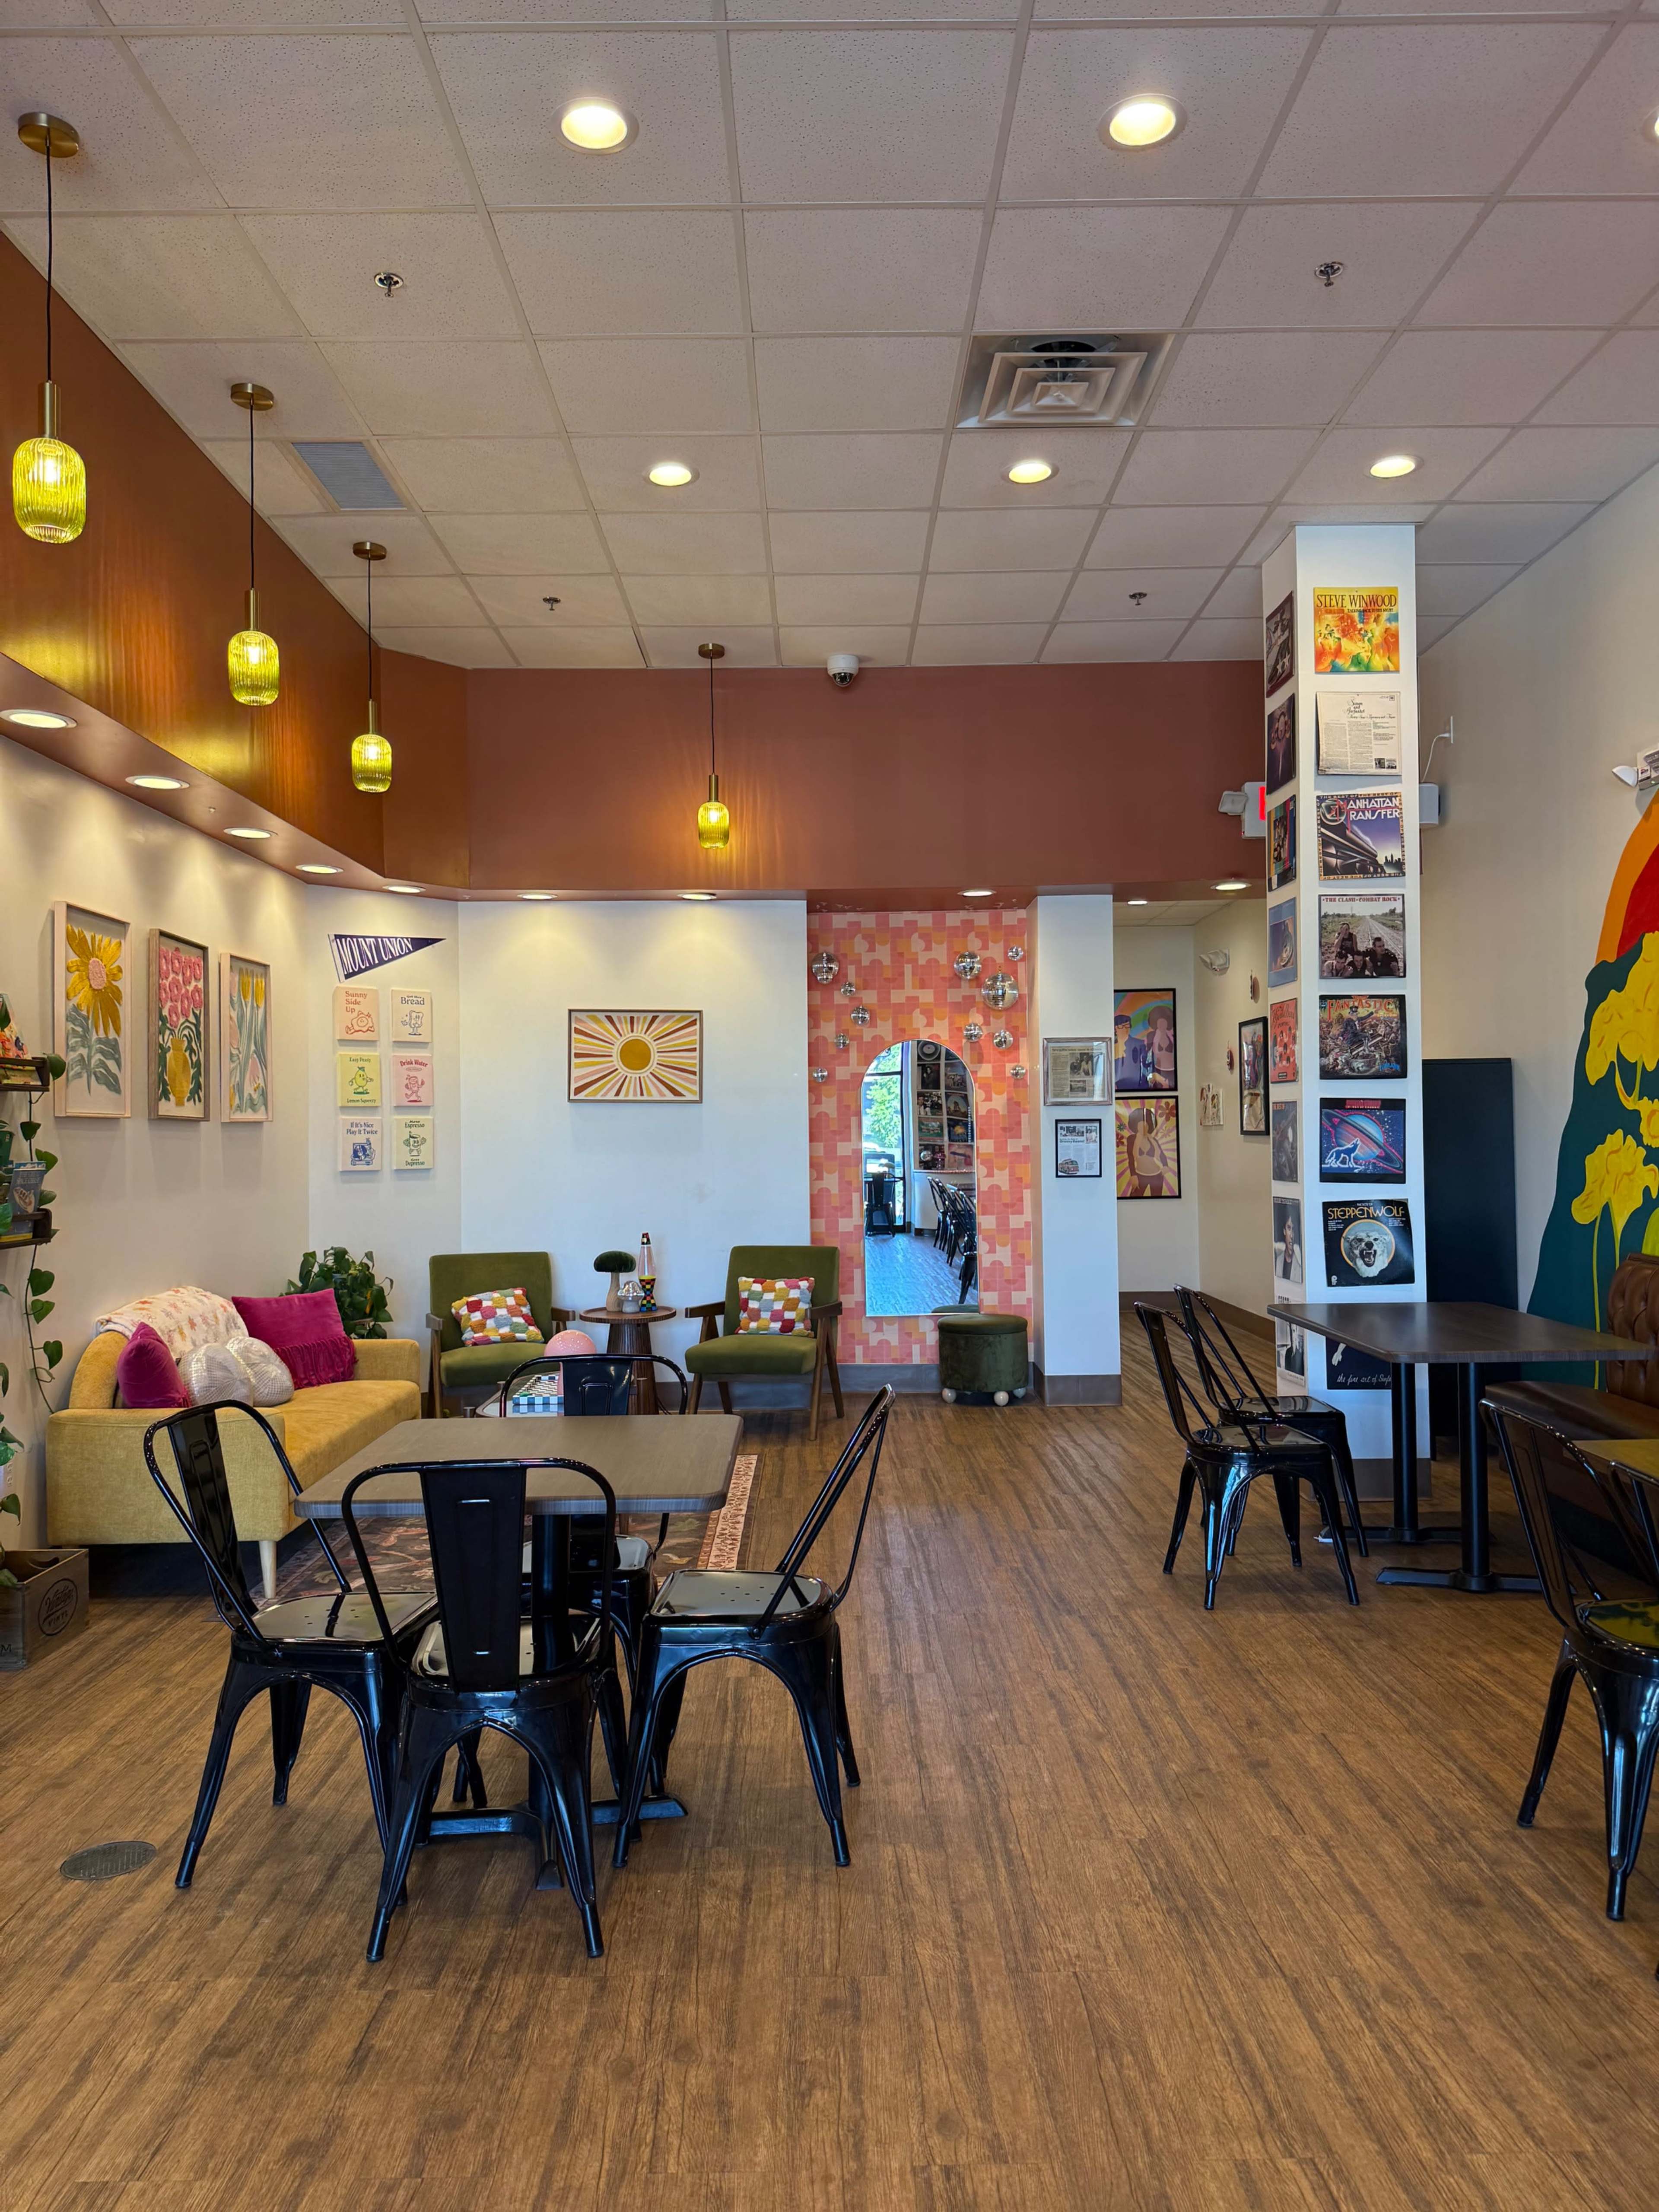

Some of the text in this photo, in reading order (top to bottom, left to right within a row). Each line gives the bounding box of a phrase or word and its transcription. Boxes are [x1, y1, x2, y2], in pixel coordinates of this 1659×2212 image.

[1316, 594, 1397, 608] STEVE WINWOOD
[337, 937, 413, 975] MOUNT UNION
[345, 991, 367, 999] Sunny
[401, 997, 425, 1005] Bread
[1327, 999, 1393, 1022] FANTASTIC
[414, 1059, 428, 1067] Water
[1328, 1205, 1405, 1219] STEPPENWOLF
[1337, 1373, 1346, 1382] the
[1347, 1374, 1358, 1386] fine
[1372, 1374, 1378, 1385] of
[1379, 1374, 1391, 1386] Surfa
